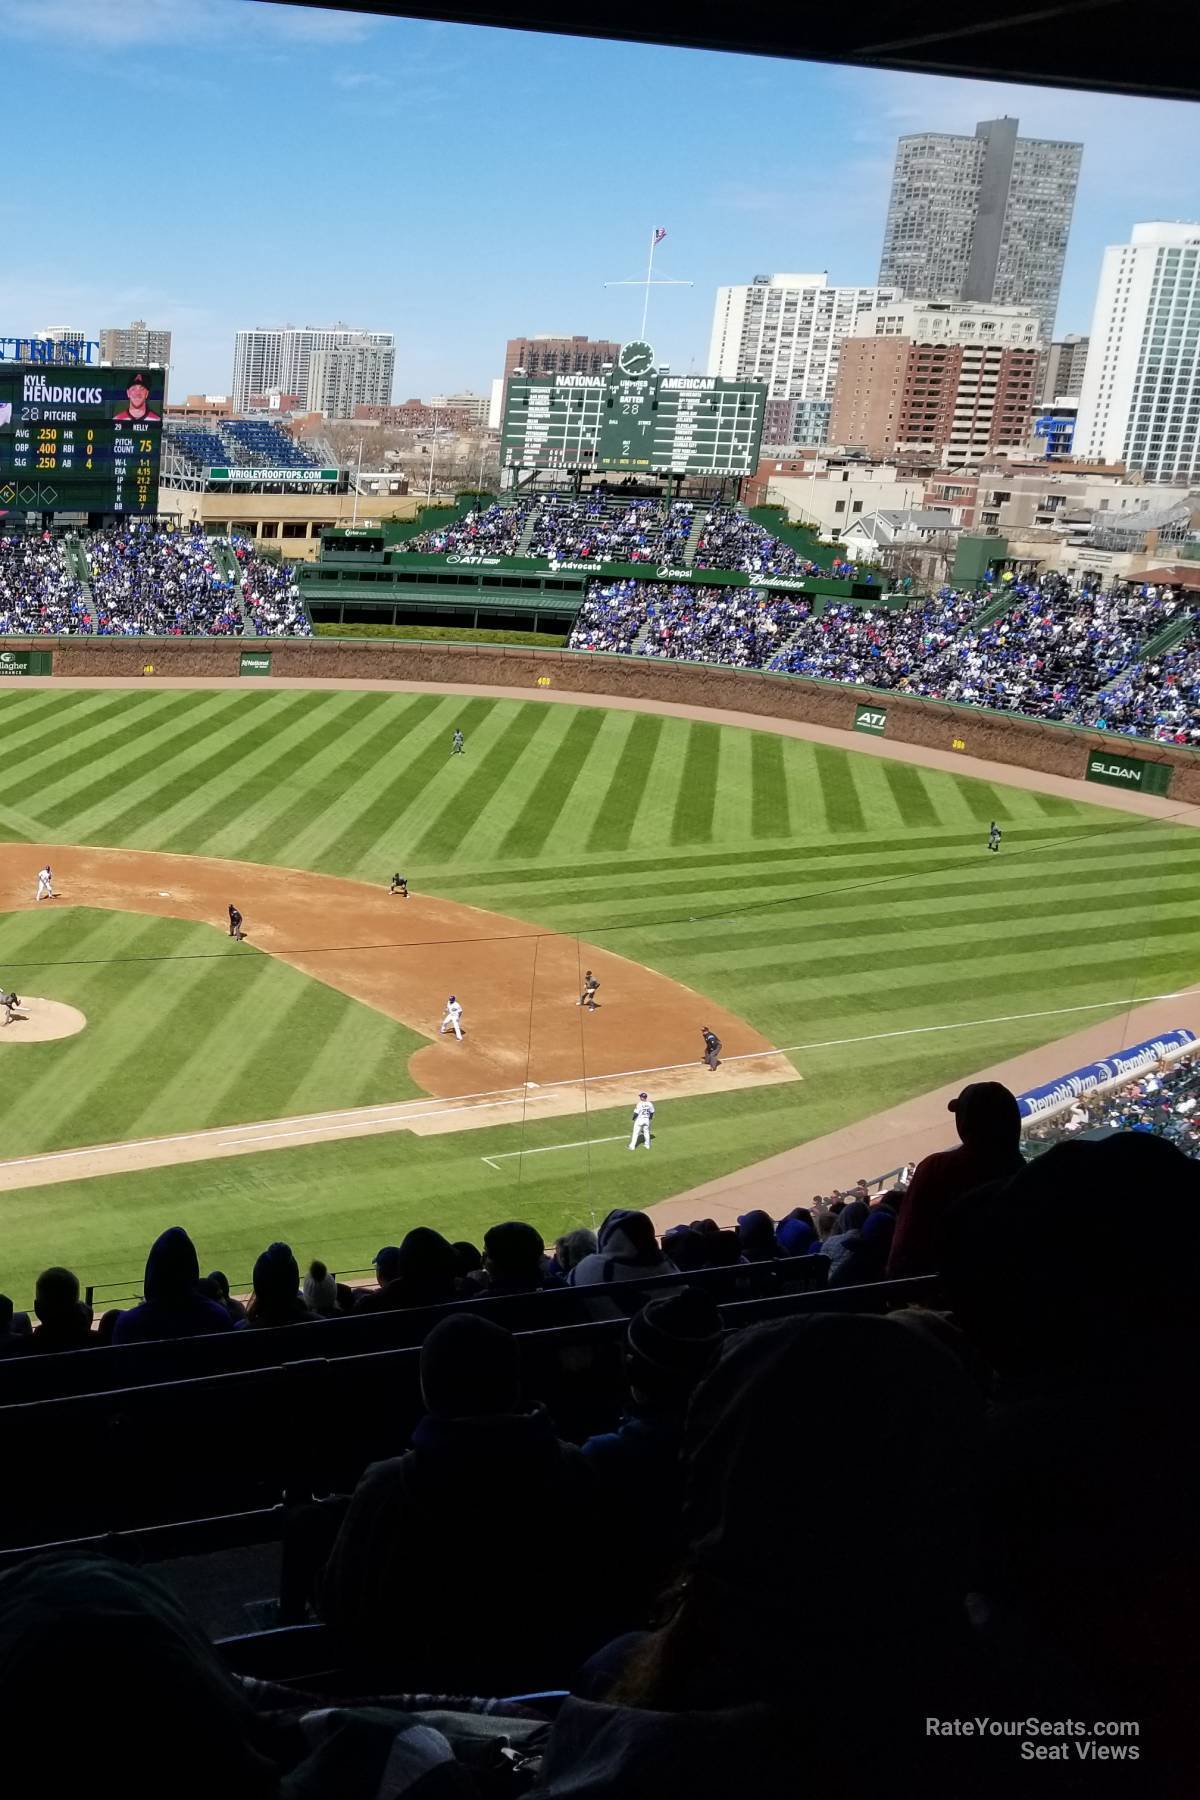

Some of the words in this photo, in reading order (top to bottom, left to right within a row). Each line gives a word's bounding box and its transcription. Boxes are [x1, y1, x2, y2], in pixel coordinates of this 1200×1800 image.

[24, 375, 46, 387] KYLE
[555, 375, 607, 388] NATIONAL
[660, 377, 716, 390] AMERICAN
[23, 386, 103, 404] HENDRICKS
[620, 395, 644, 403] BATTER
[21, 407, 39, 421] 28
[43, 411, 77, 422] PITCHER
[622, 403, 640, 415] 28
[15, 429, 30, 438] AVG
[37, 429, 57, 441] .250
[63, 431, 73, 439] HR
[87, 430, 93, 441] 0
[115, 438, 133, 446] PITCH
[139, 440, 152, 453] 75
[15, 444, 29, 452] OBP
[36, 443, 56, 455] .400
[63, 445, 74, 453] RBI
[86, 445, 93, 455] 0
[113, 446, 134, 454] COUNT
[622, 445, 630, 455] 2
[14, 458, 27, 467] SLG
[35, 457, 56, 469] .250
[62, 459, 72, 467] AB
[86, 459, 92, 469] 4
[114, 458, 127, 466] W-L
[114, 467, 126, 475] ERA
[228, 469, 321, 479] WRIGLEYROOFTOPS.COM
[459, 556, 482, 565] ATI
[561, 561, 602, 571] Advocate
[668, 569, 692, 578] pepsi
[749, 574, 805, 588] Budweiser
[857, 712, 886, 725] ATI
[1091, 762, 1141, 781] SLOAN
[1114, 1048, 1157, 1075] Reynolds
[1028, 1083, 1073, 1113] Reynolds
